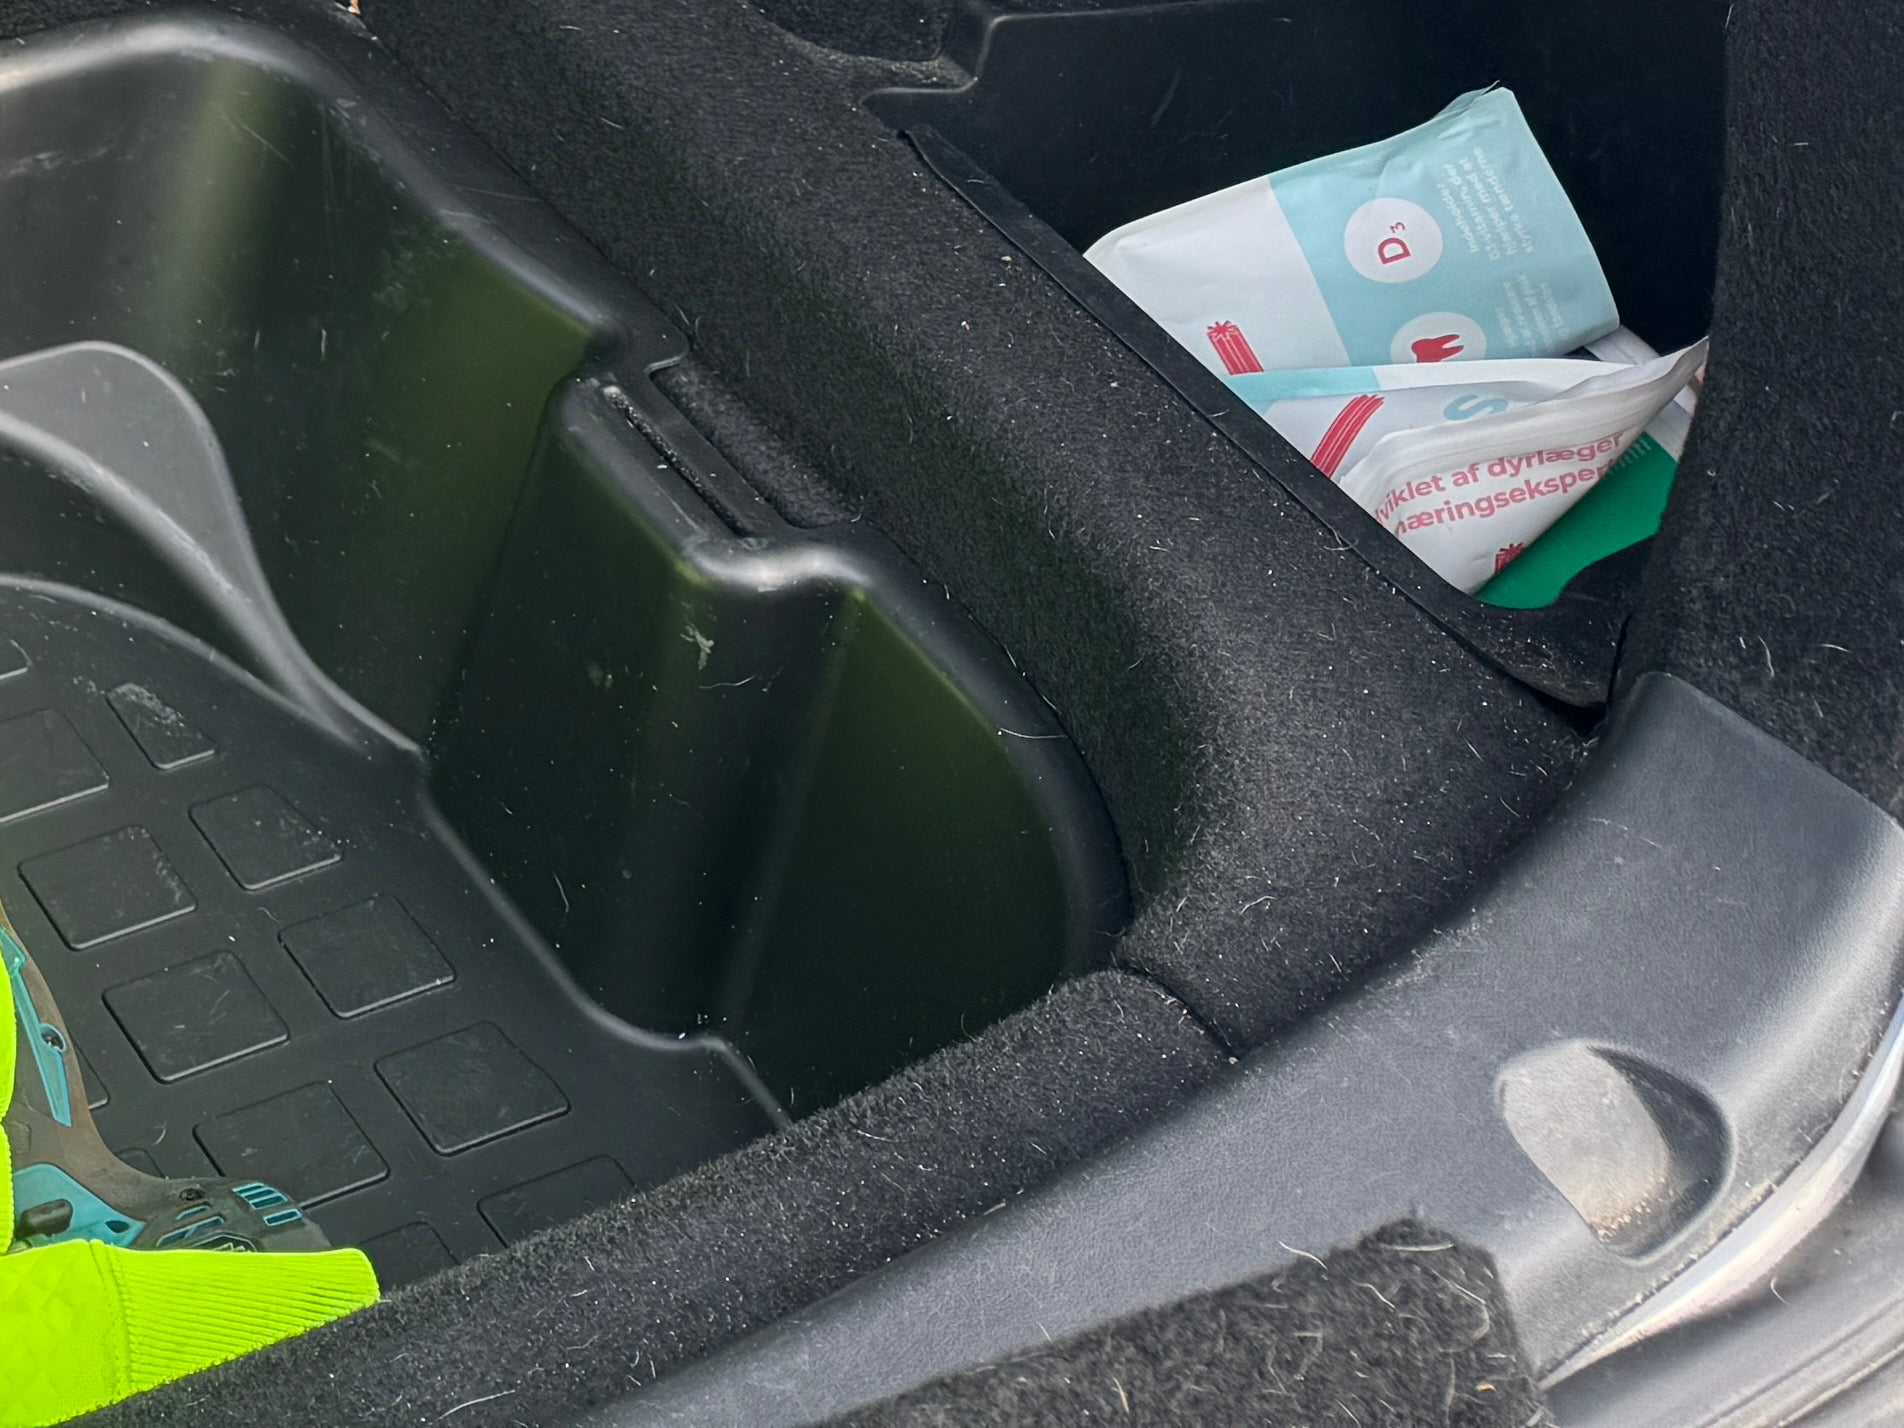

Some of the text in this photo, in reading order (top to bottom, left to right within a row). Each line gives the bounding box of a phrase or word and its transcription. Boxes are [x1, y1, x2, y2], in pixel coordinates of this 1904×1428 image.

[1373, 473, 1446, 525] viklet
[1451, 461, 1481, 488] af
[1486, 430, 1625, 478] dyrlæger
